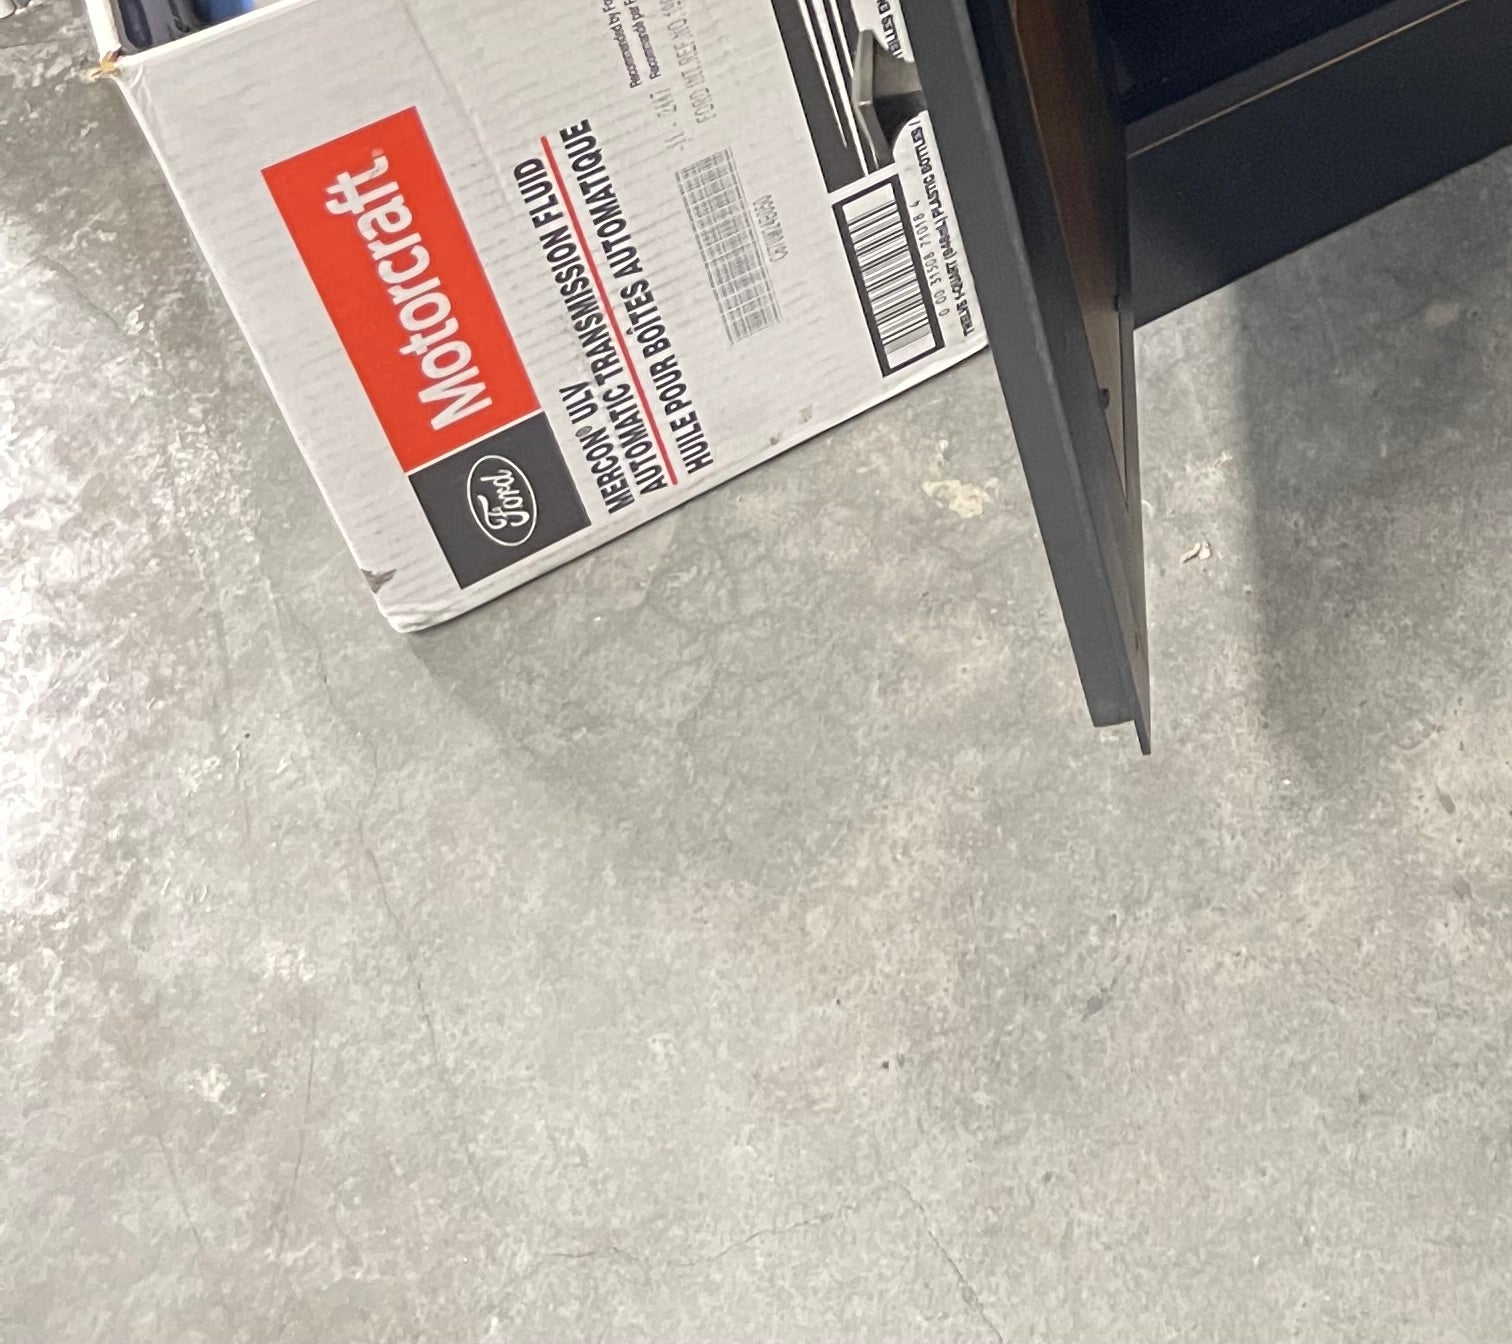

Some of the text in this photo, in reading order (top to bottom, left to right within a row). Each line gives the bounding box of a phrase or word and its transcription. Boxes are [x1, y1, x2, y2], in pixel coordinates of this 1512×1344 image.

[608, 10, 623, 28] by
[910, 126, 933, 175] BOTTLES
[923, 173, 946, 219] PLASTIC
[324, 153, 494, 432] Motorcraft
[558, 118, 714, 476] HUILE POUR BOÎTES AUTOMATIQUE
[512, 157, 669, 496] AUTOMATIC TRANSMISSION FLUID
[558, 380, 600, 425] ULV
[477, 468, 531, 530] Ford
